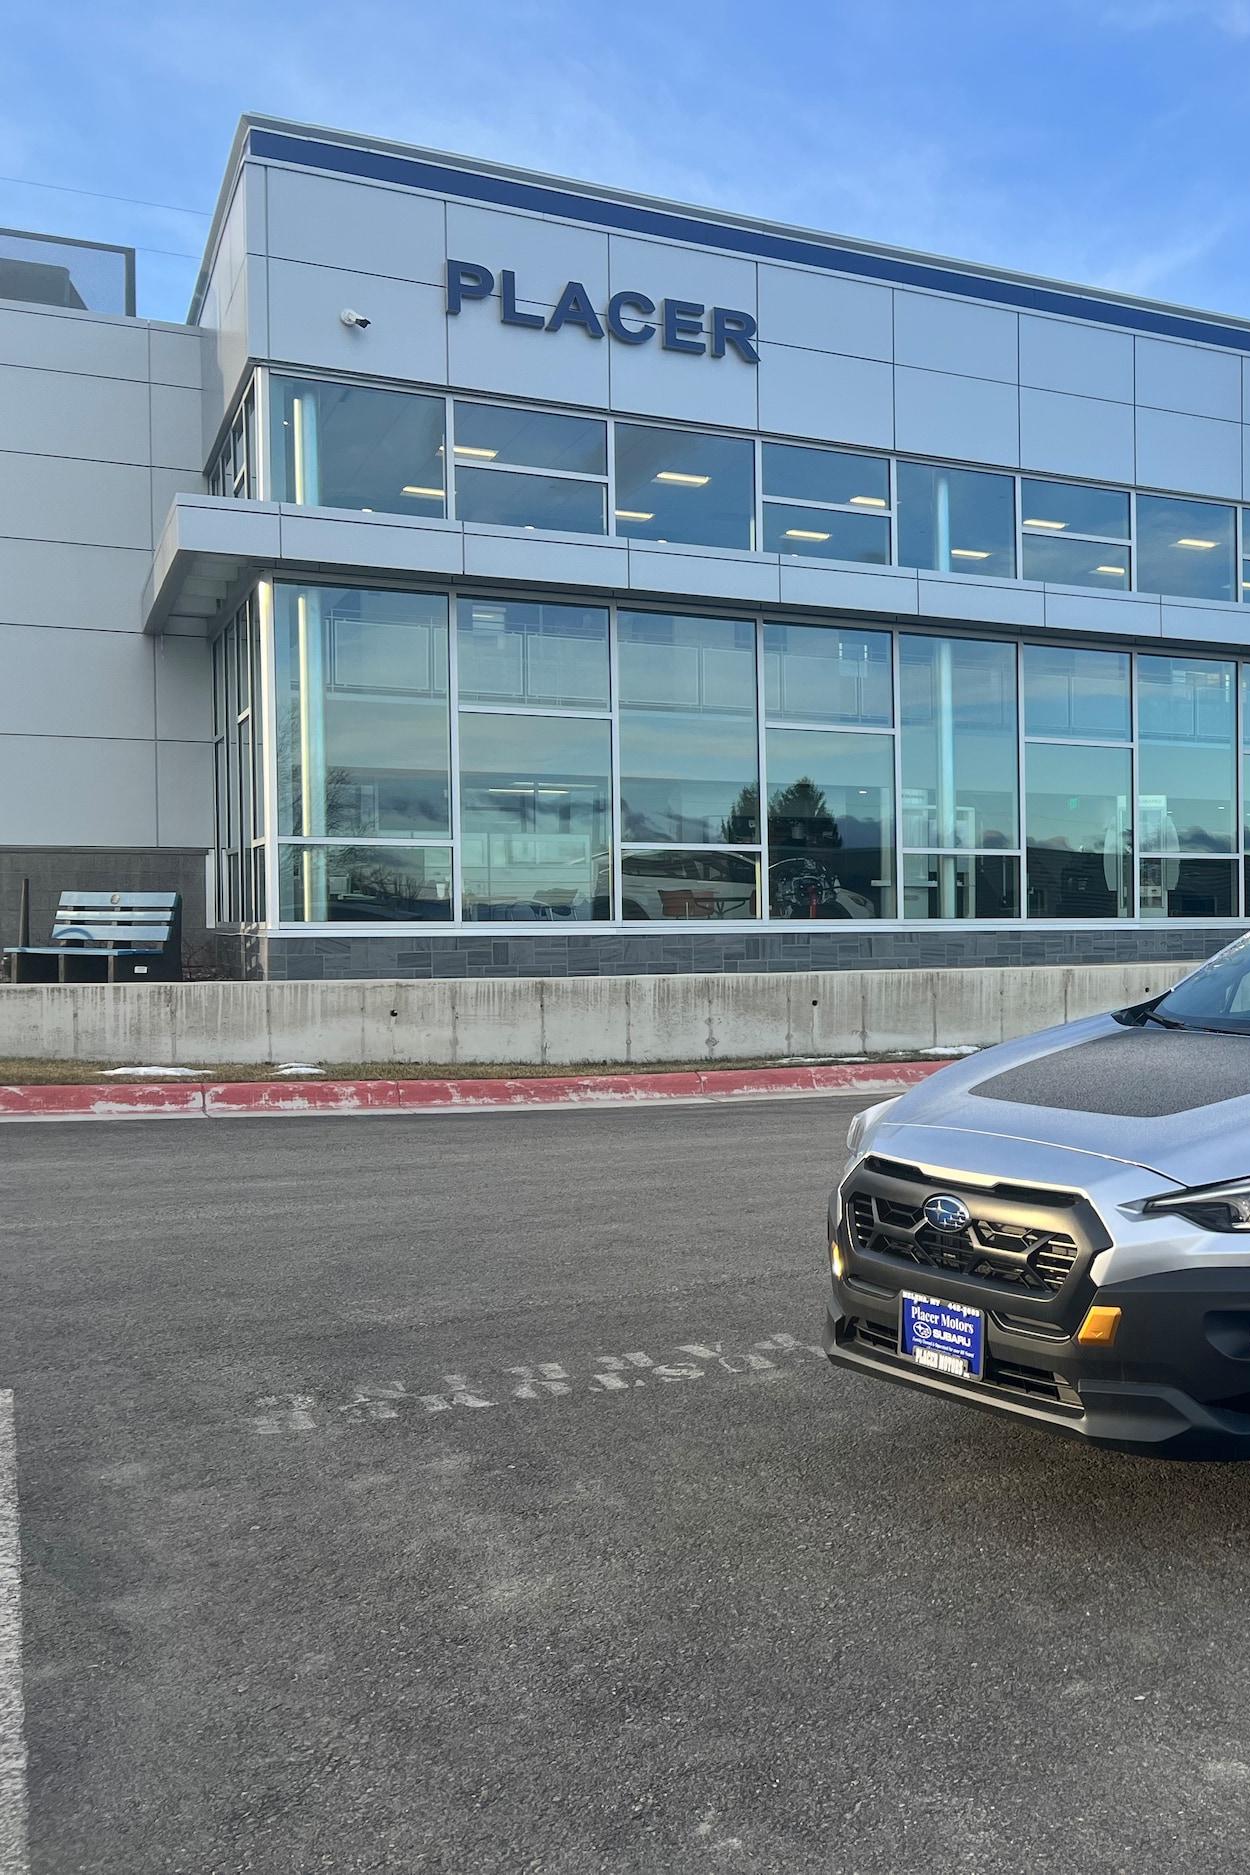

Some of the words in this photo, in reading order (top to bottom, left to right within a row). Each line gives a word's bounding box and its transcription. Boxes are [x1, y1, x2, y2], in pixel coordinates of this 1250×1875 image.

[446, 258, 761, 363] PLACER
[911, 1305, 940, 1325] Placer
[941, 1313, 974, 1334] Motors
[932, 1328, 972, 1347] SUBARU
[915, 1347, 938, 1369] PLACER
